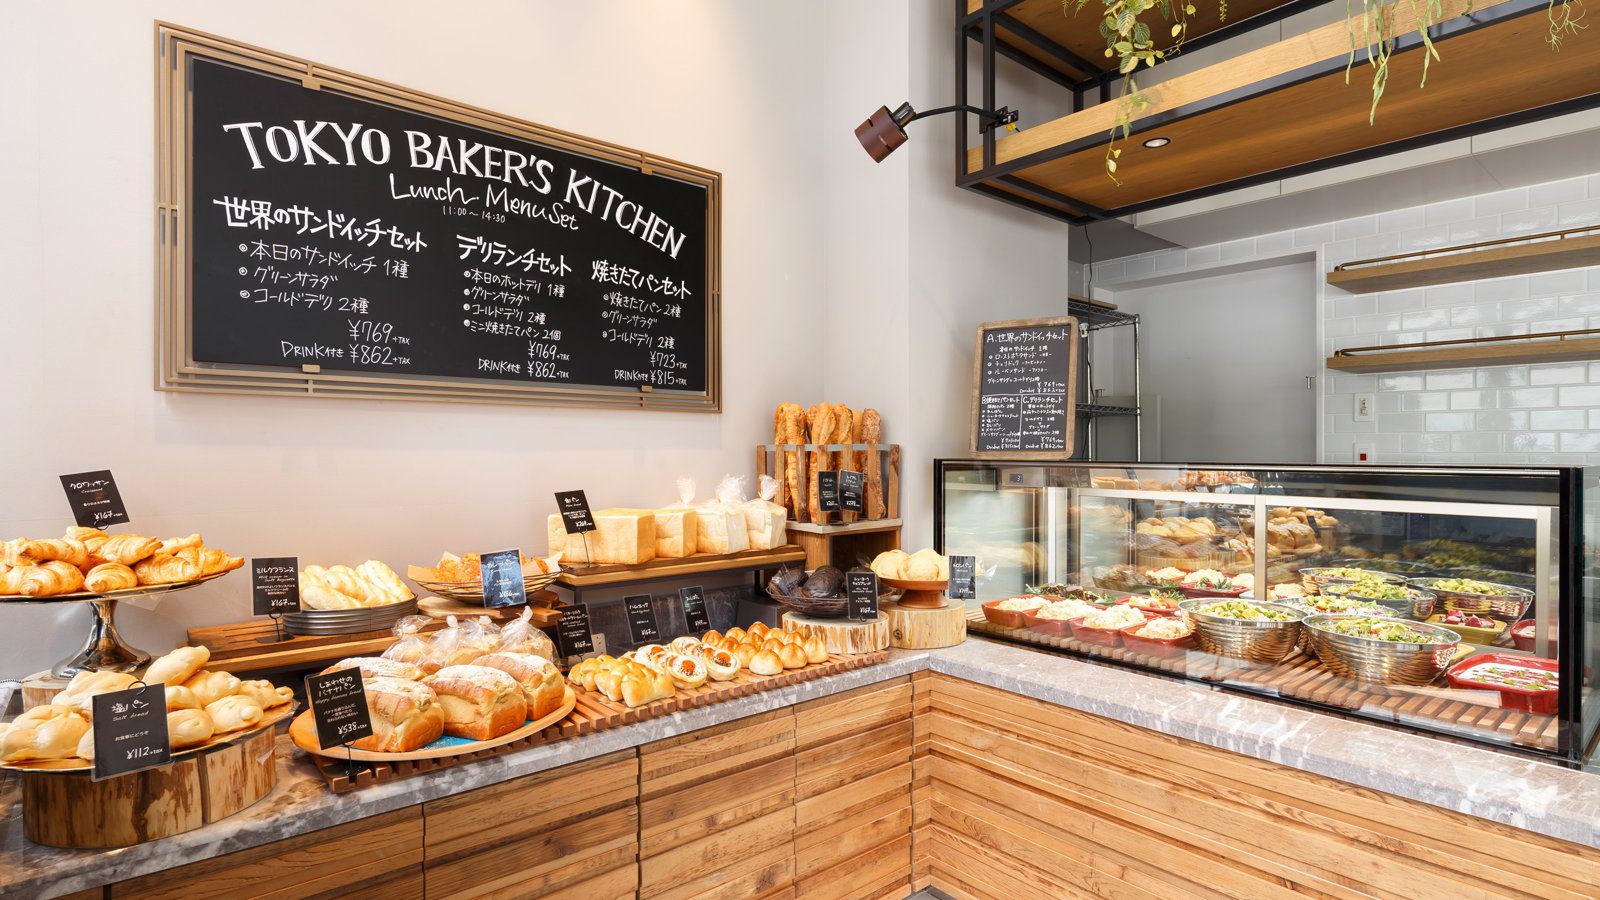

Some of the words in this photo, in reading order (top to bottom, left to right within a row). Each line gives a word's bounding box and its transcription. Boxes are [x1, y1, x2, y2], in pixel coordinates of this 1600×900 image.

[223, 119, 391, 170] TOKYO
[404, 130, 554, 195] BAKER'S
[564, 168, 687, 259] KITCHEN
[389, 173, 478, 204] Lunch
[486, 184, 547, 220] Menu
[548, 202, 579, 231] Set
[213, 196, 428, 252] 世界のサンドイッチセット
[250, 239, 378, 274] 本日のサンドイッチ
[383, 259, 411, 279] 1種
[456, 234, 573, 277] デリランチセット
[254, 266, 339, 290] グリーンサラダ
[470, 268, 542, 294] 本日のホットデリ
[547, 283, 566, 299] 1種
[592, 259, 692, 300] 焼きたてパンセット
[254, 288, 333, 312] コールドデリ
[338, 297, 371, 315] 2種
[470, 285, 531, 308] グリーンサラダ
[609, 291, 662, 314] 焼きたてパン
[664, 303, 682, 318] 2種
[471, 303, 524, 323] コールドデリ
[528, 311, 547, 326] 2種
[609, 311, 658, 330] グリーンサラダ
[470, 320, 540, 338] ミニ焼きたてパン
[543, 328, 562, 342] 2個
[609, 329, 653, 349] コールドデリ
[658, 336, 676, 351] 2種
[281, 340, 345, 359] DRINK付き
[478, 357, 521, 375] DRINK付き
[70, 480, 109, 490] クロワッサン
[318, 682, 356, 697] バナナパン
[319, 676, 353, 689] しあわせの
[111, 699, 150, 714] 塩パン
